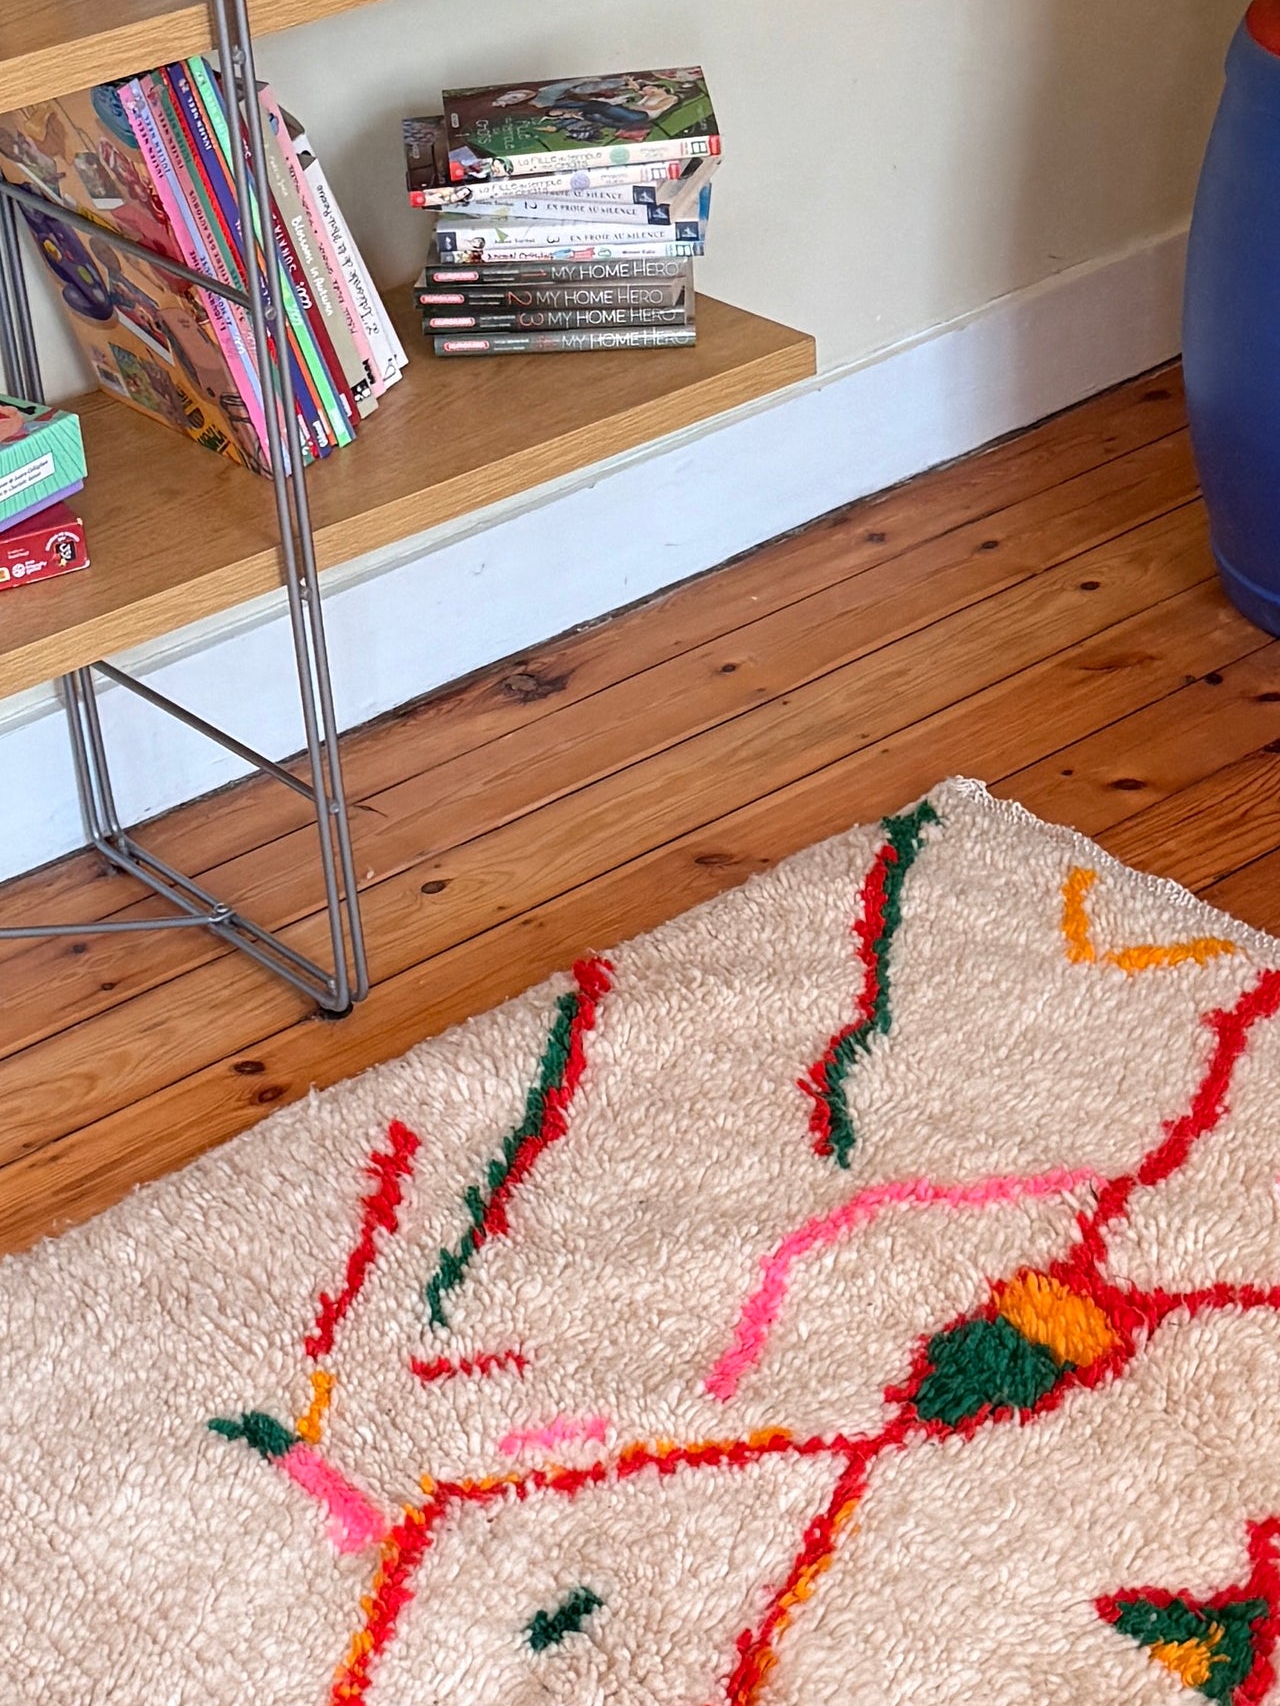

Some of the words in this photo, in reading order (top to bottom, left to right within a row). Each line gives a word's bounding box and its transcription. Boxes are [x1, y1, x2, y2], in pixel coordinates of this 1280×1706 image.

[586, 206, 600, 214] AU
[289, 215, 316, 265] Blossoms
[307, 264, 321, 279] in
[551, 262, 576, 278] MY
[579, 263, 629, 278] HOME
[633, 261, 679, 276] HERO
[311, 275, 336, 317] Autumn
[506, 292, 532, 306] 2
[536, 292, 561, 307] MY
[564, 290, 614, 306] HOME
[618, 288, 663, 304] HERO
[519, 313, 544, 327] 3
[548, 312, 573, 328] MY
[576, 310, 626, 325] HOME
[629, 306, 676, 322] HERO
[561, 335, 586, 350] MY
[589, 333, 640, 348] HOME
[643, 327, 689, 344] HERO
